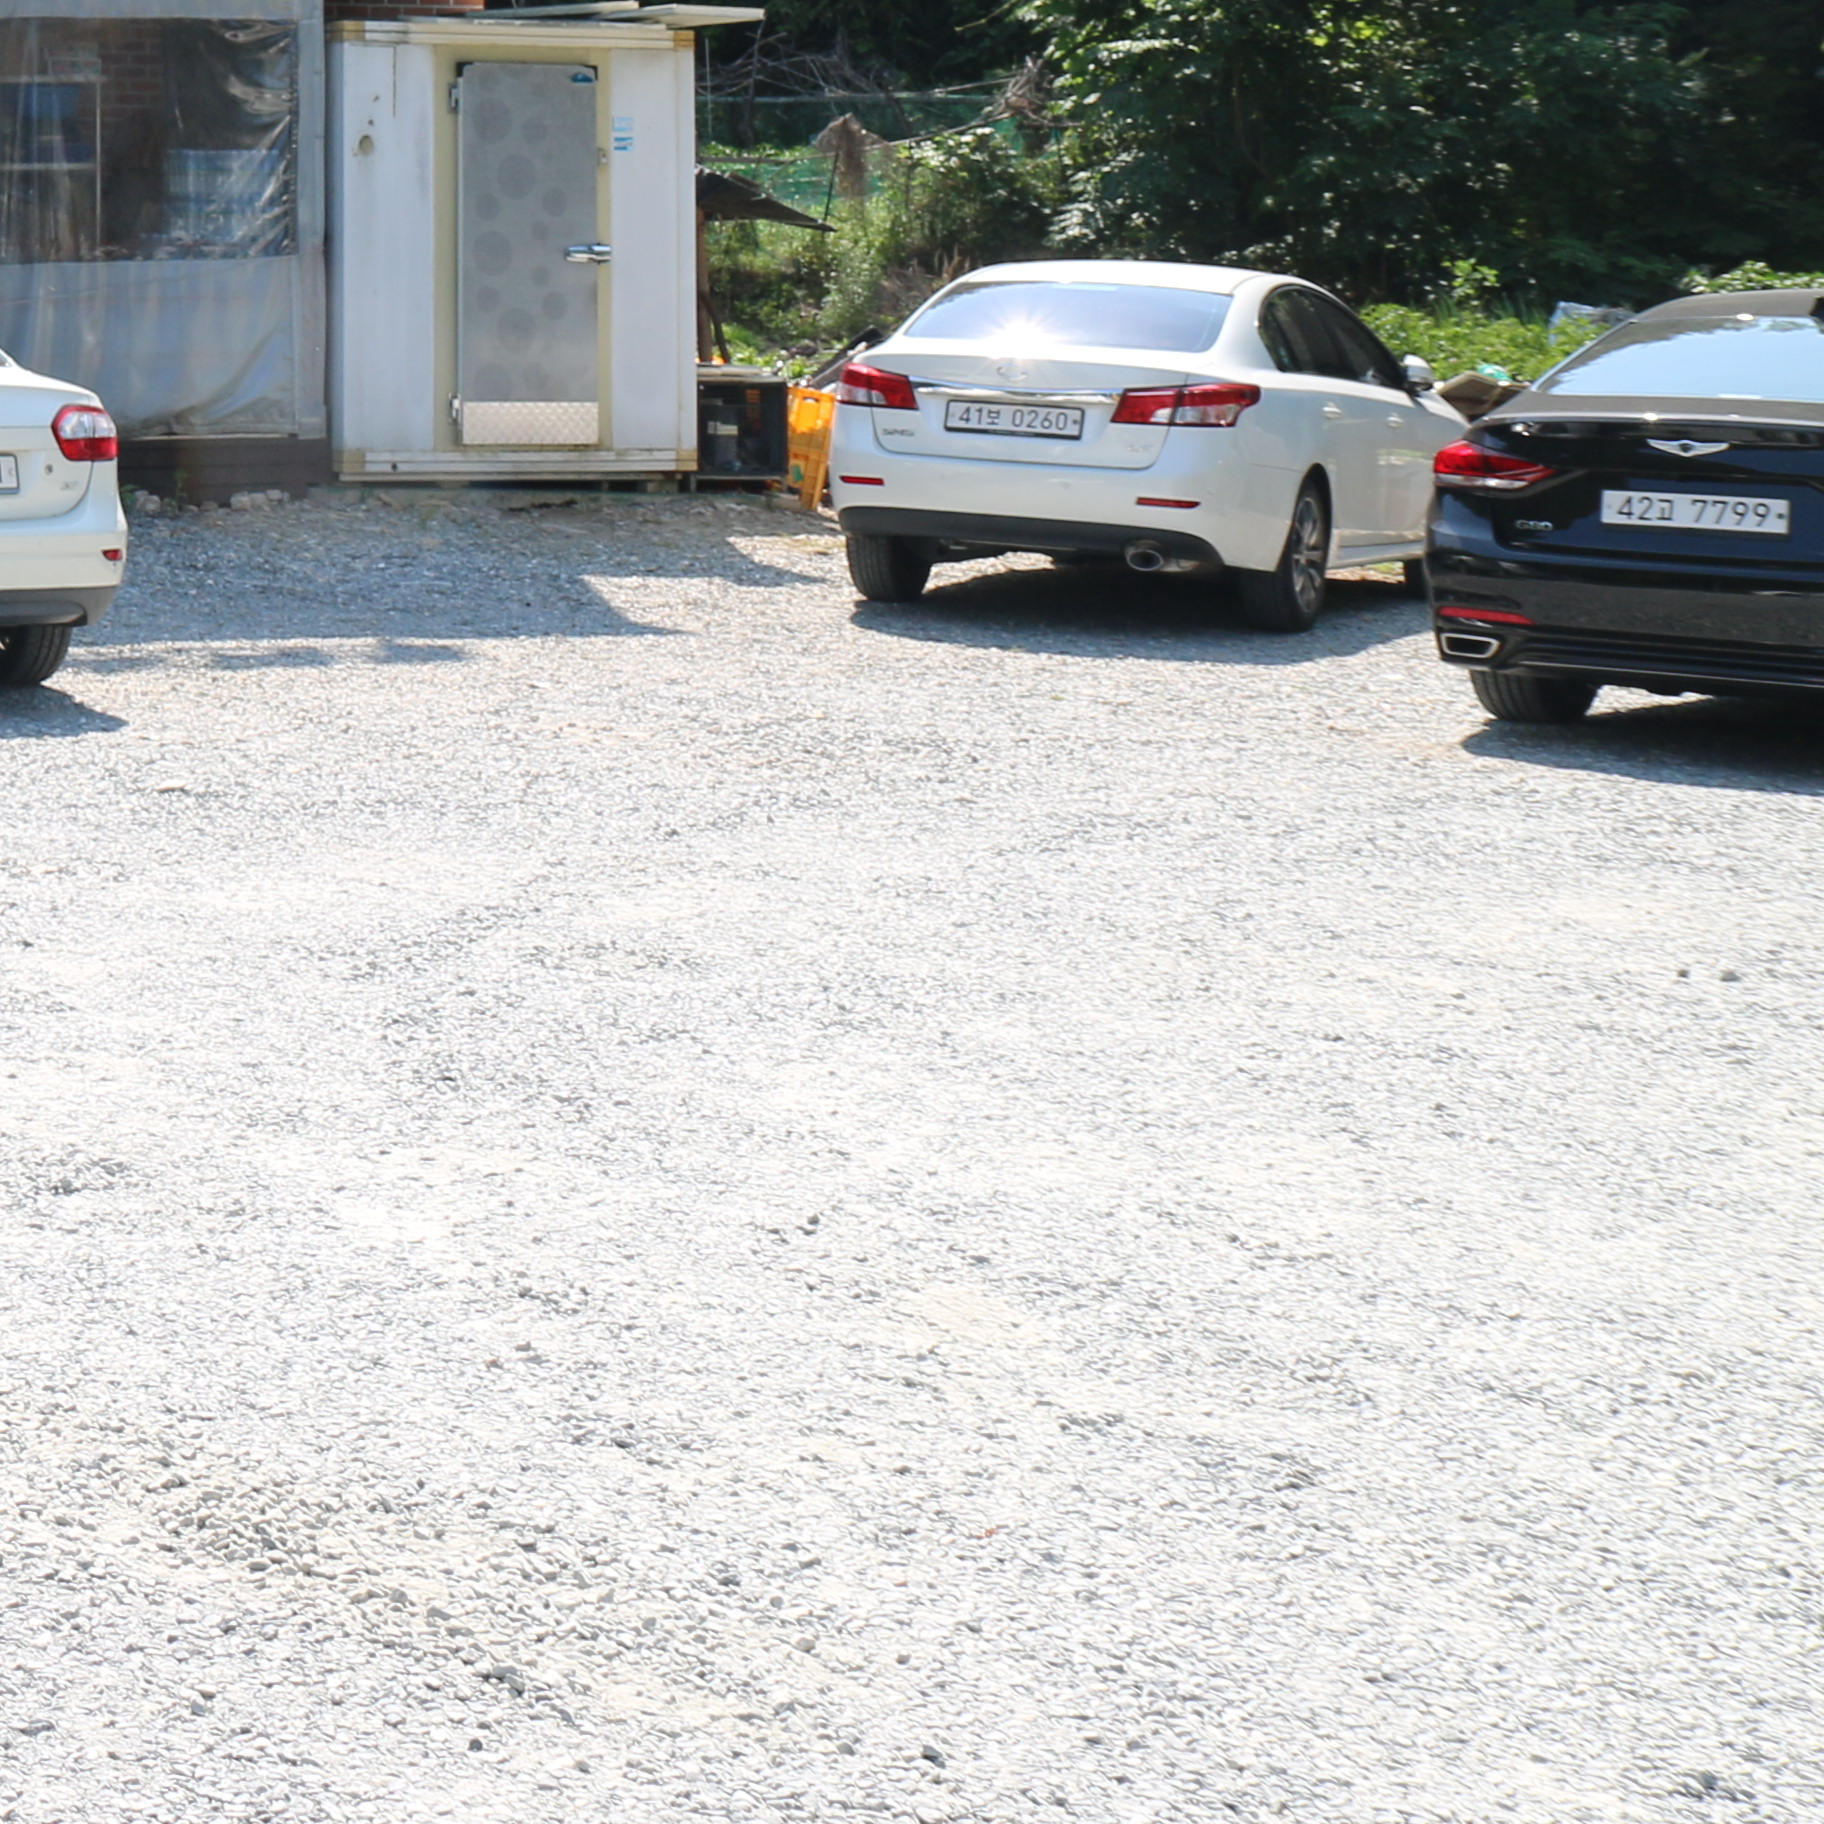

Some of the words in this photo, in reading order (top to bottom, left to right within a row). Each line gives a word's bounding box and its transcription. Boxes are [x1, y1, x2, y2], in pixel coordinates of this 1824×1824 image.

[959, 406, 1001, 426] 41보
[1011, 408, 1069, 431] 0260
[1617, 496, 1674, 522] 42고
[1691, 498, 1771, 527] 7799
